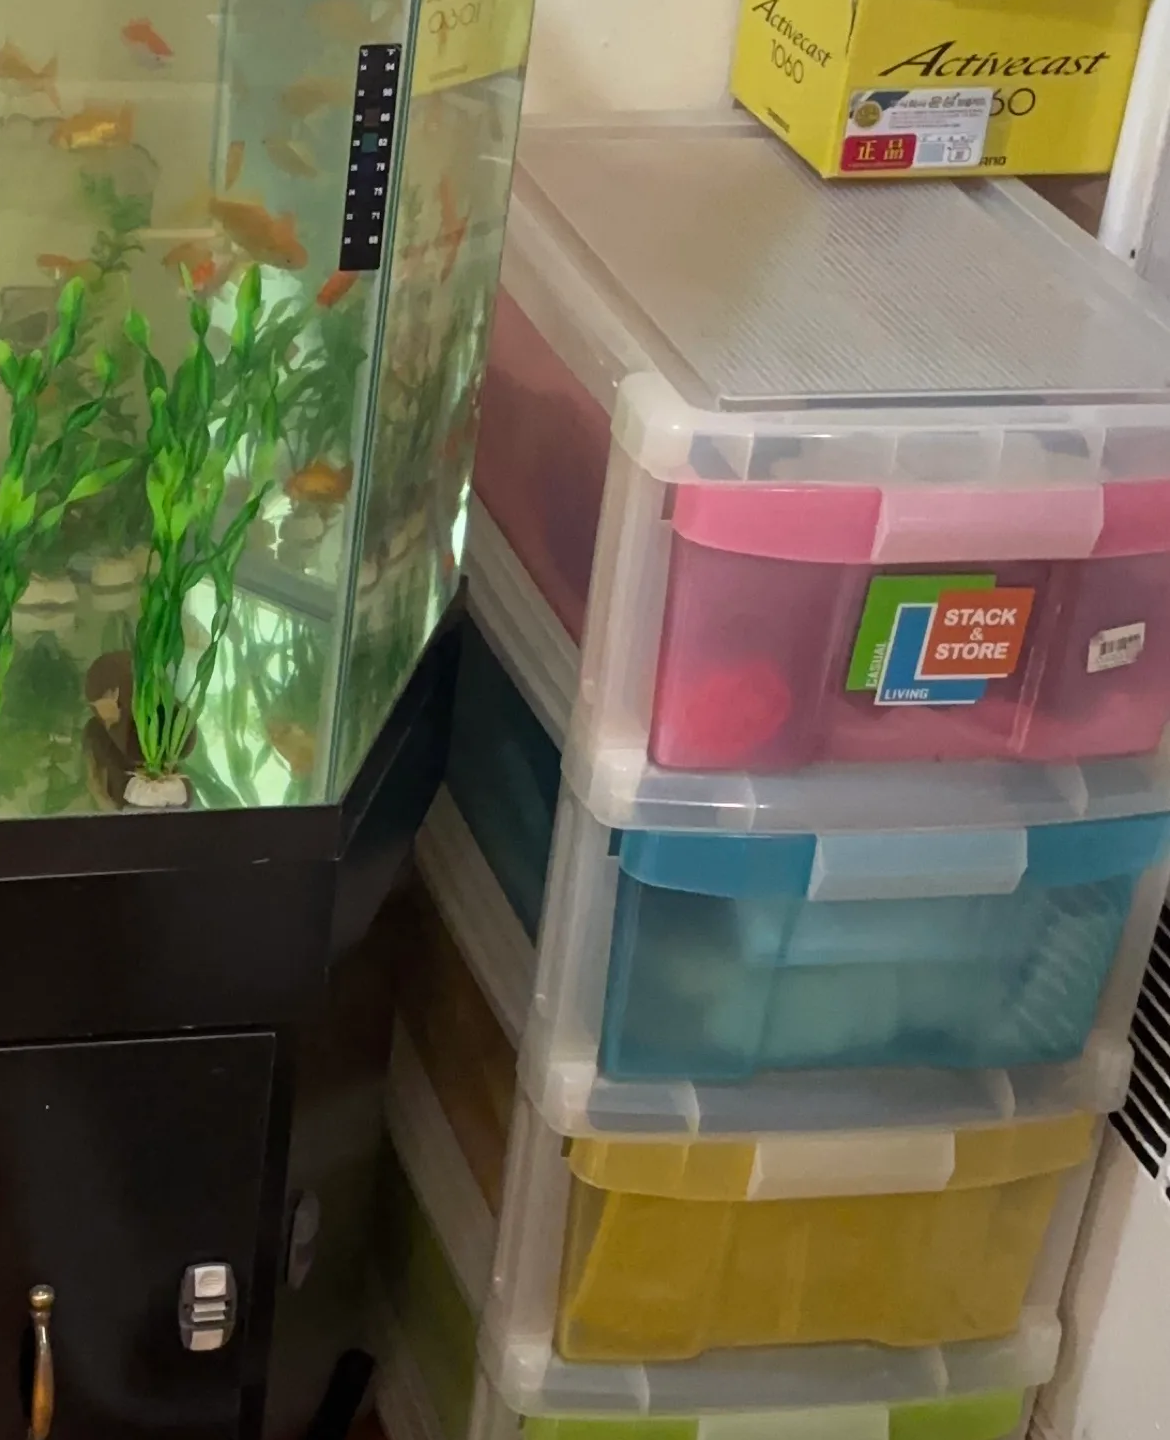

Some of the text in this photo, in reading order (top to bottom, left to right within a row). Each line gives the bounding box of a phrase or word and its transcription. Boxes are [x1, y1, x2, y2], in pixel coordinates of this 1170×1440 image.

[771, 38, 804, 84] 1060
[878, 40, 1111, 77] Activecast
[943, 608, 1018, 626] STACK
[969, 627, 984, 641] &
[934, 642, 1010, 660] STORE
[865, 643, 887, 688] CASUAL
[884, 688, 929, 700] LIVING
